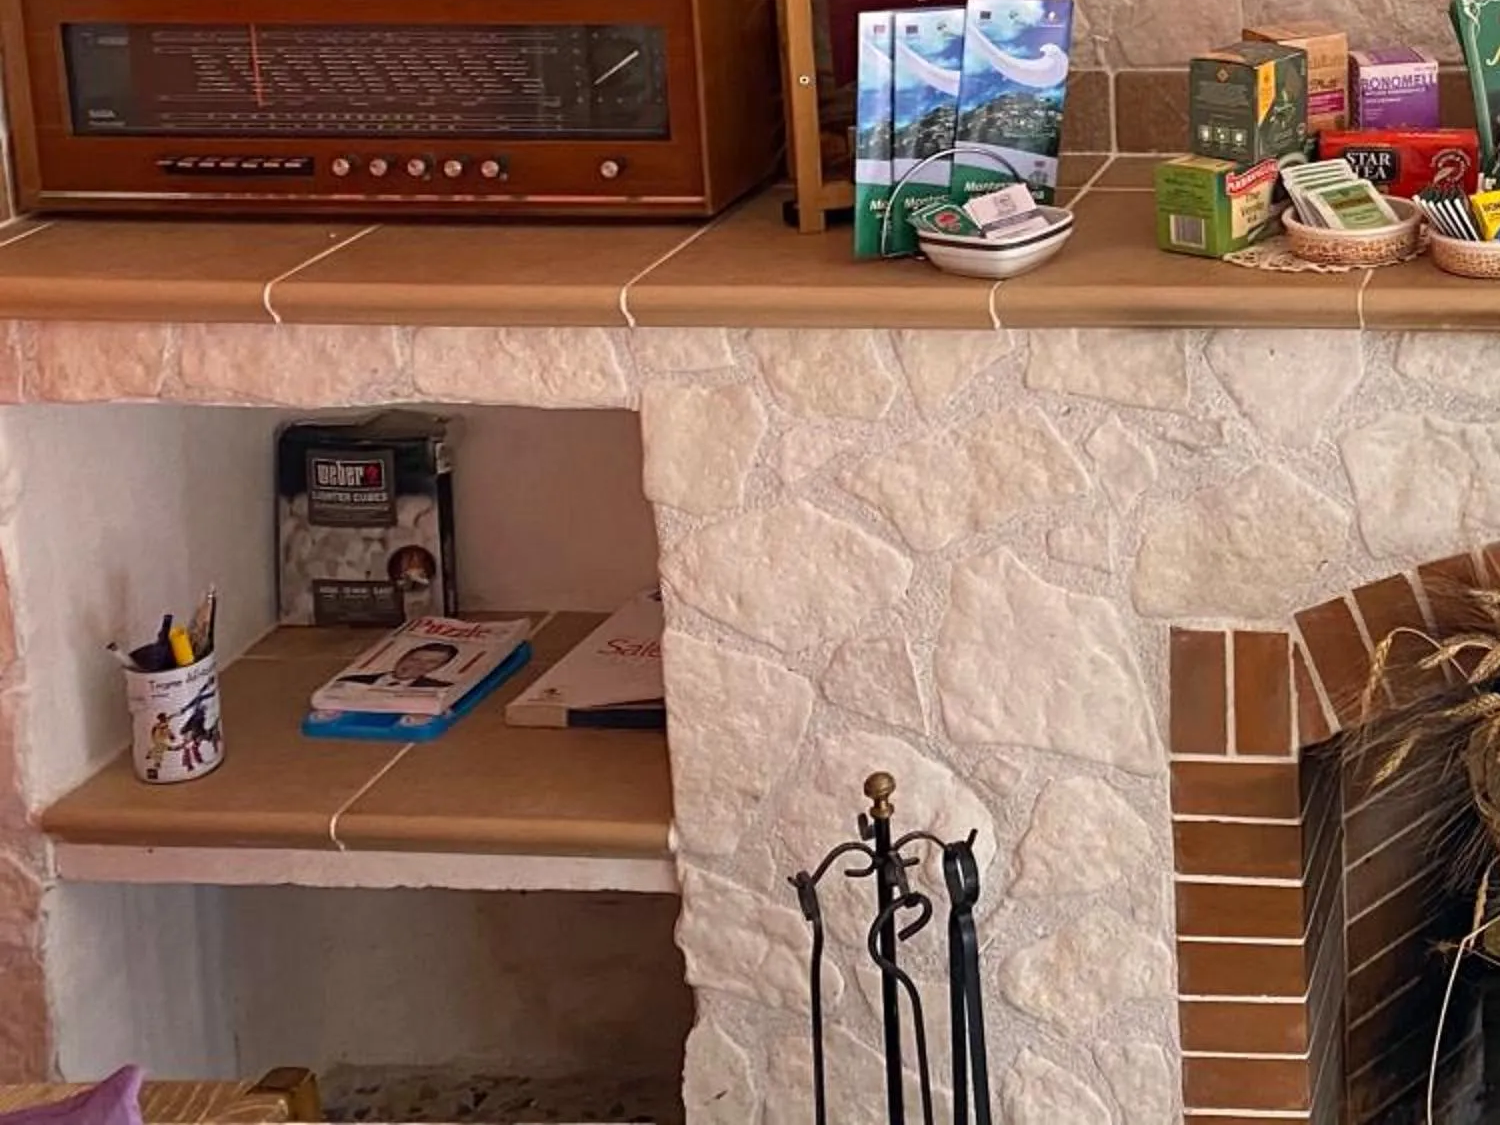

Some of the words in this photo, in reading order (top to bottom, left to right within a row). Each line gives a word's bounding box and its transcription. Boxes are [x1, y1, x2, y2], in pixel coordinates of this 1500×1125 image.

[1346, 151, 1391, 166] STAR
[1353, 165, 1387, 179] TEA
[317, 461, 364, 486] weber
